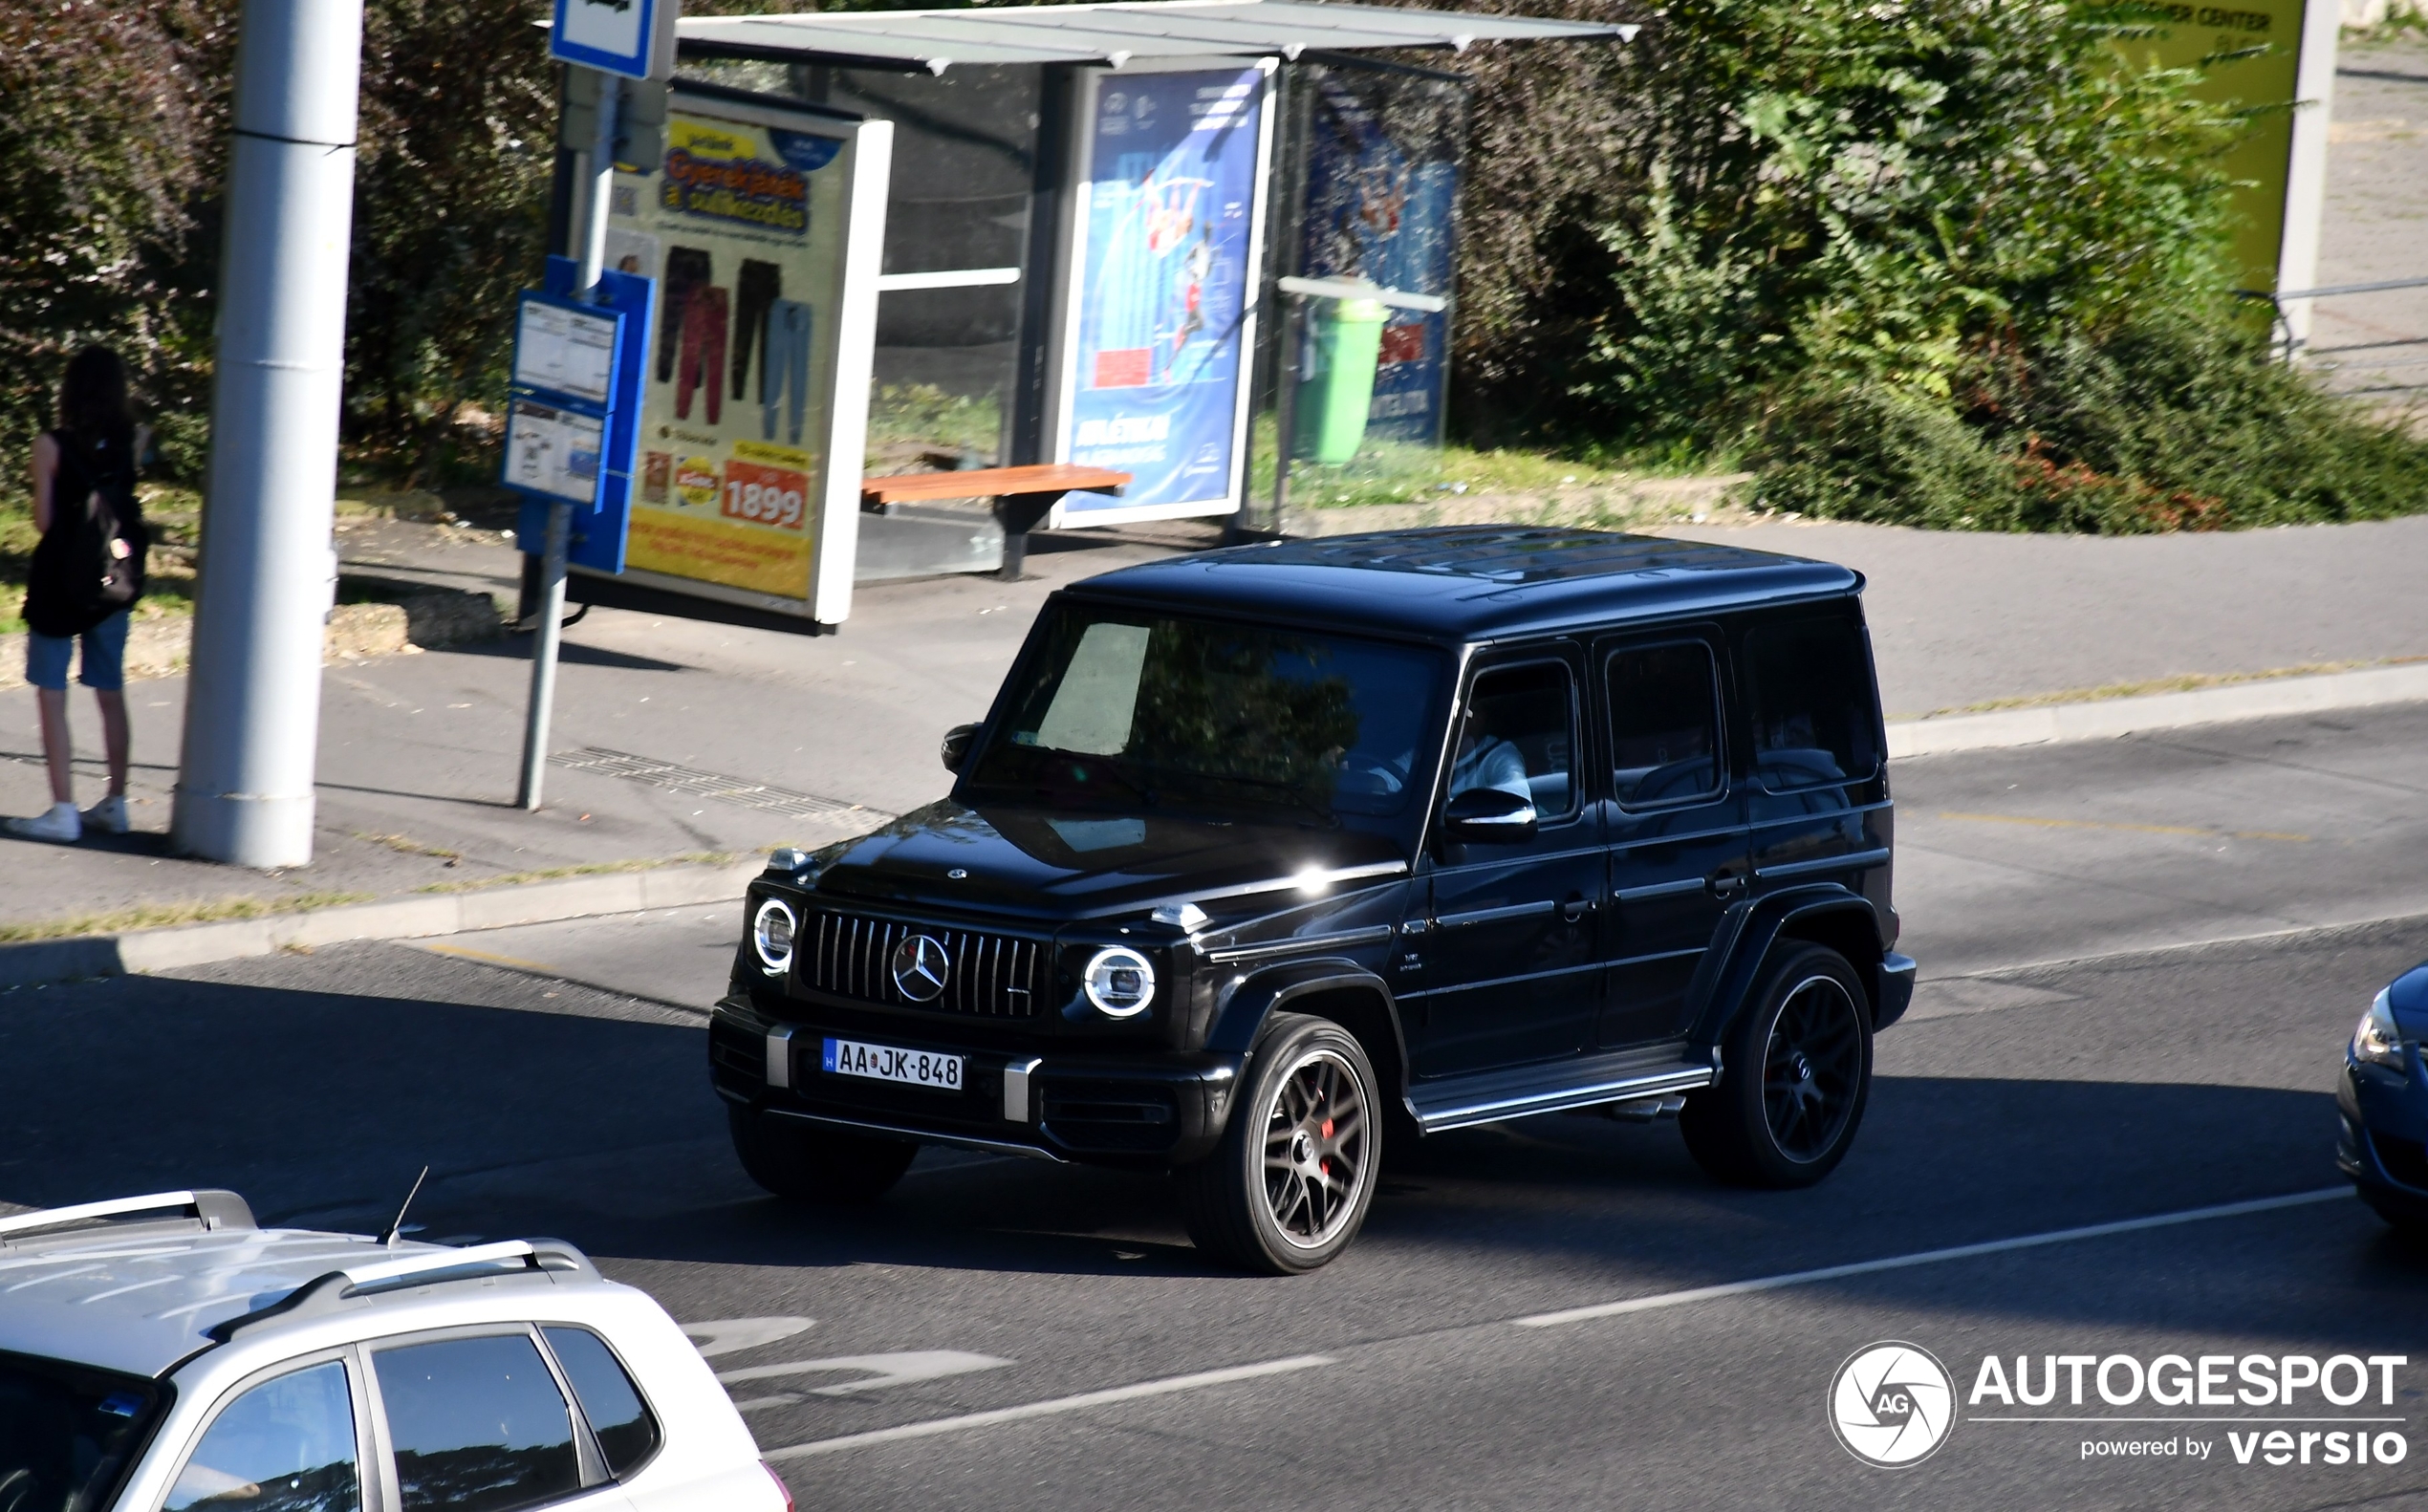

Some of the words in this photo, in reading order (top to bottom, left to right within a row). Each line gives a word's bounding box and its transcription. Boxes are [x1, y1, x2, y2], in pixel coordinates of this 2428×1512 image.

[2200, 6, 2271, 32] CENTER
[726, 480, 803, 525] 1899
[825, 1056, 834, 1069] H
